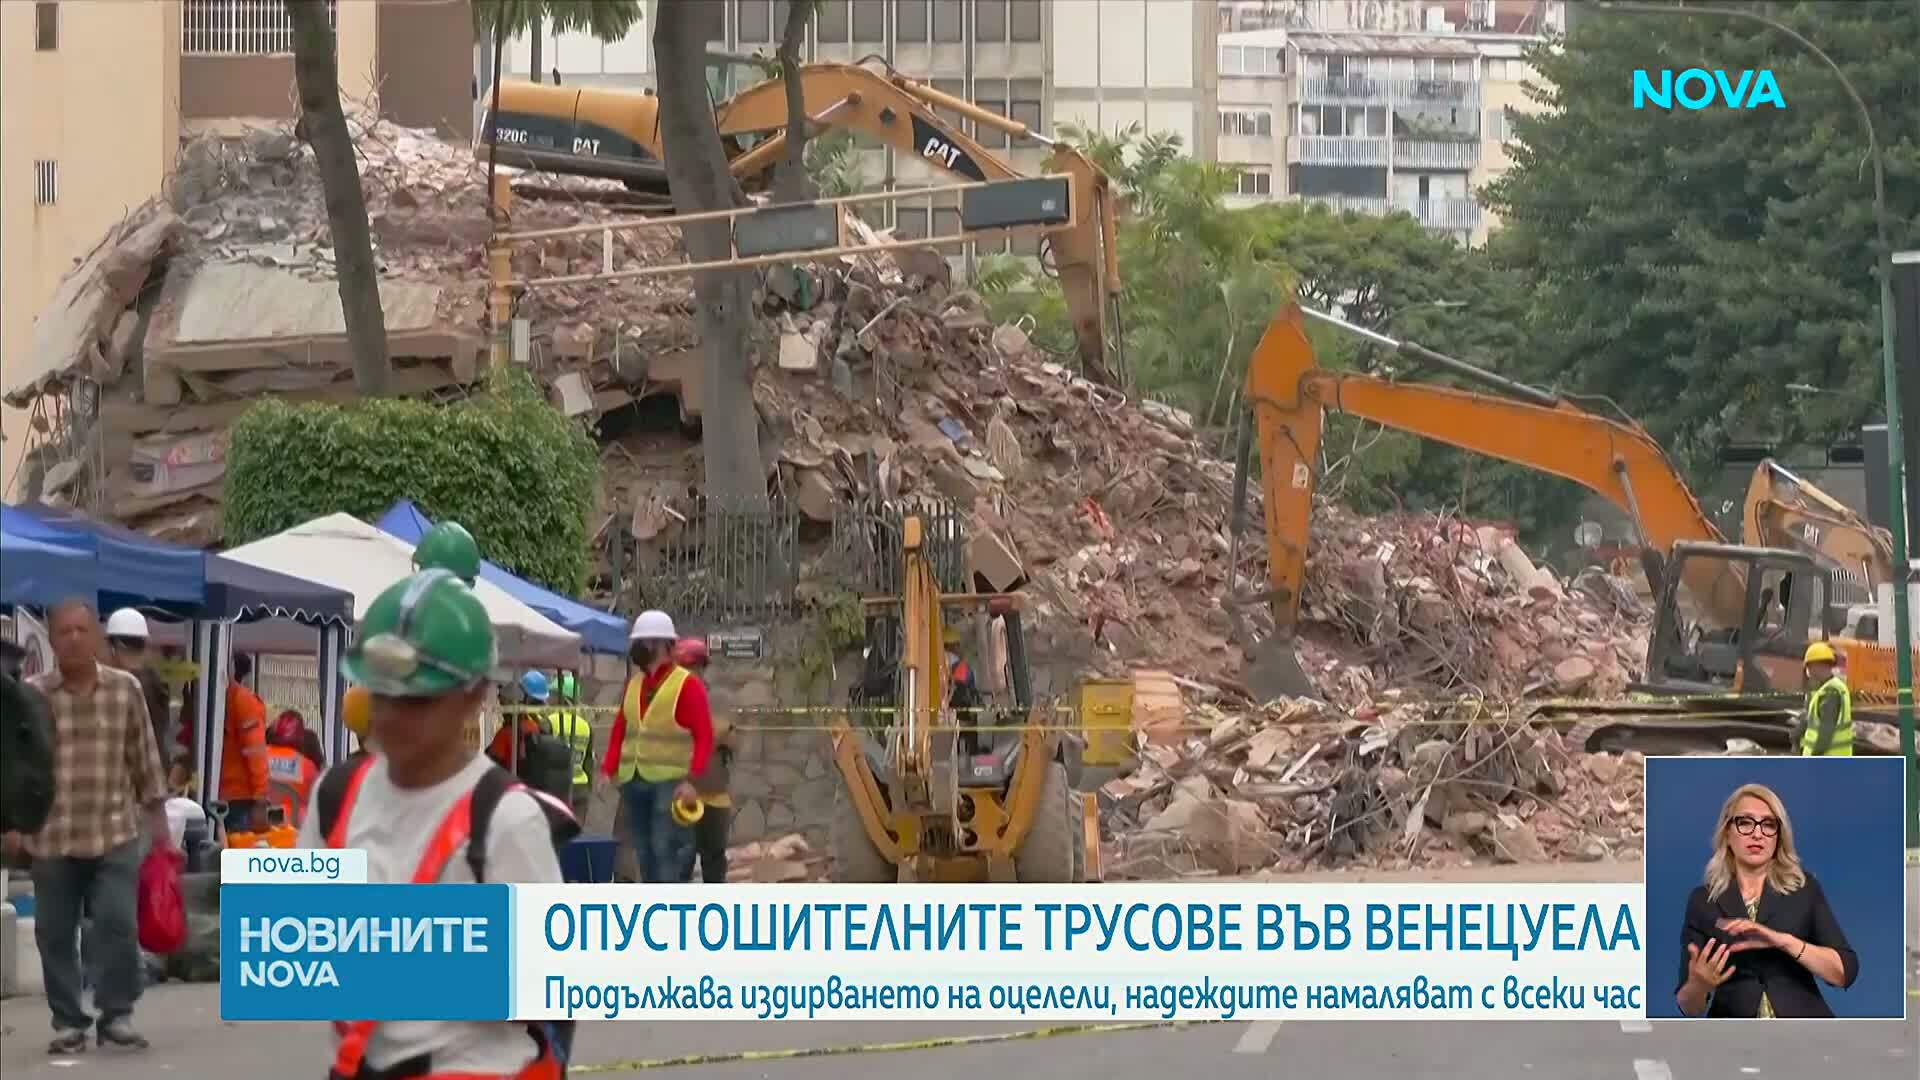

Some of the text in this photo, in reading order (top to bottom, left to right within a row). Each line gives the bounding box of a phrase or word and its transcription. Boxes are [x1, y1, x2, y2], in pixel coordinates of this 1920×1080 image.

[495, 127, 529, 144] 320C
[572, 137, 600, 157] CAT
[923, 137, 961, 169] CAT
